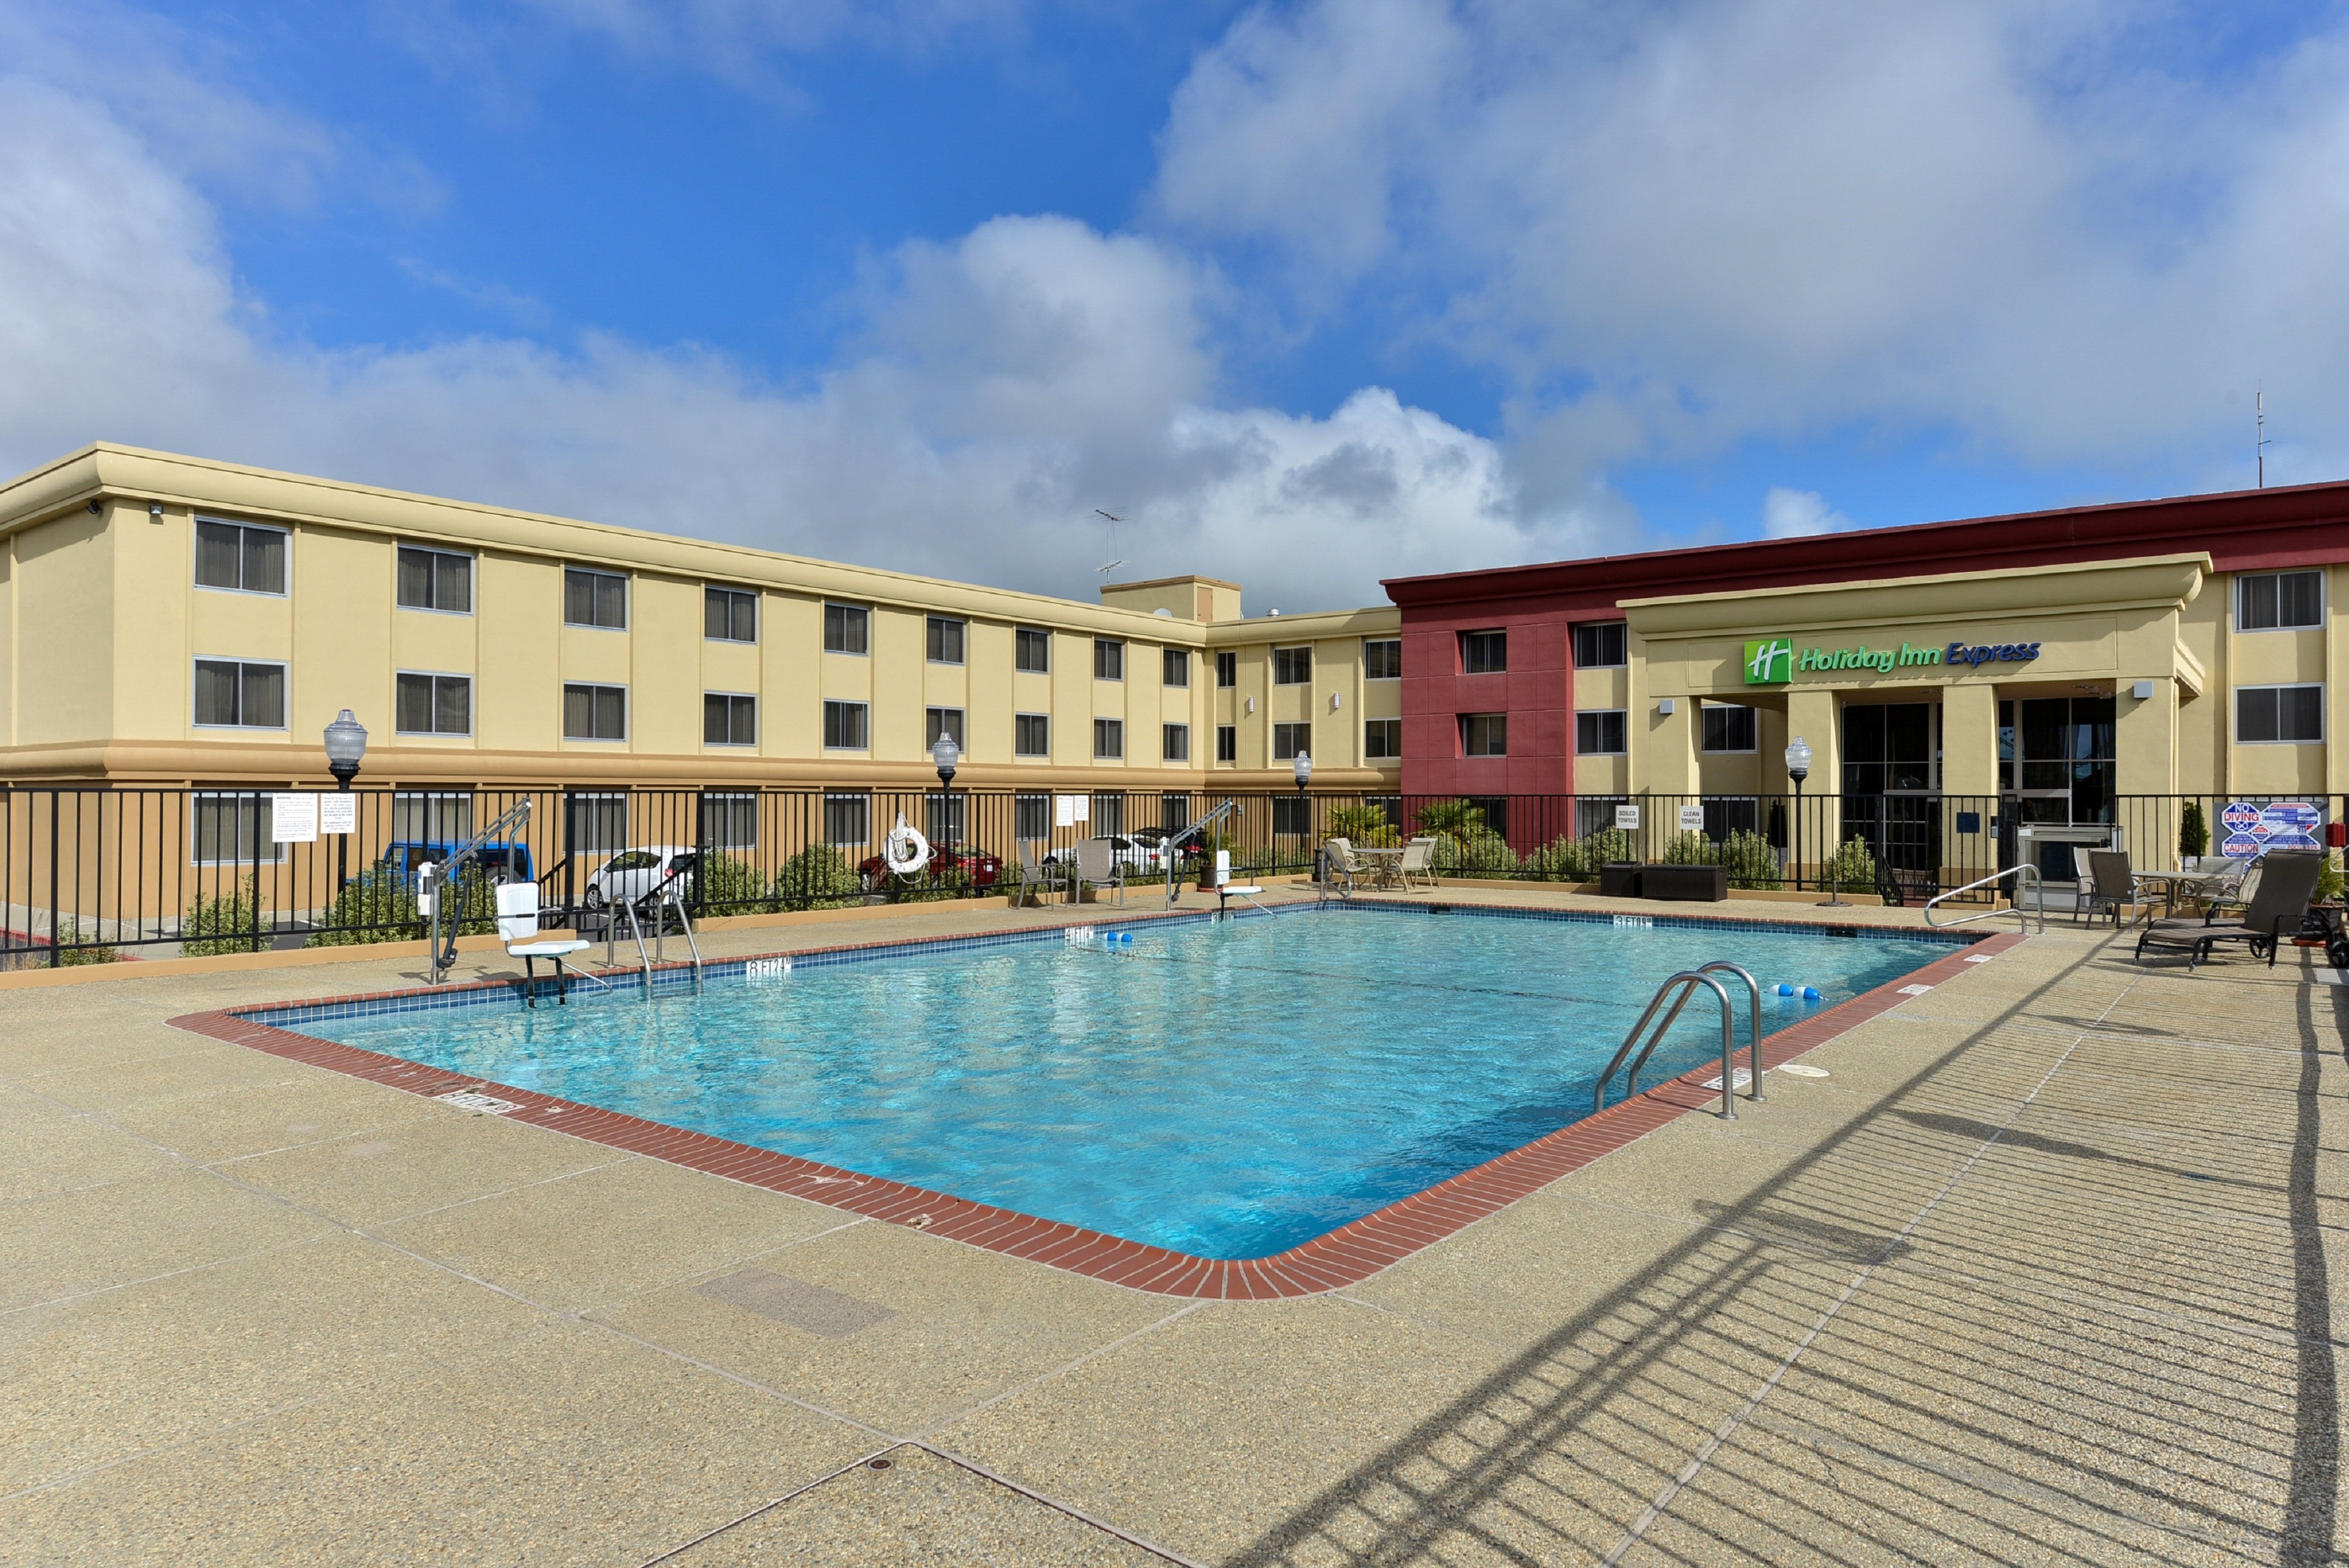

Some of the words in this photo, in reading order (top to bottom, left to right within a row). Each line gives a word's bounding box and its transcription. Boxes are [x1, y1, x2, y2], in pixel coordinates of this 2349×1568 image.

[1798, 645, 1898, 674] Holiday
[1899, 642, 1942, 666] Inn
[1945, 642, 2041, 668] Express
[2235, 804, 2249, 812] NO
[2297, 825, 2306, 833] 911
[2224, 844, 2259, 852] CAUTION
[1616, 915, 1623, 925] 3
[1626, 916, 1636, 926] FT
[749, 960, 758, 973] 8
[762, 960, 774, 973] FT
